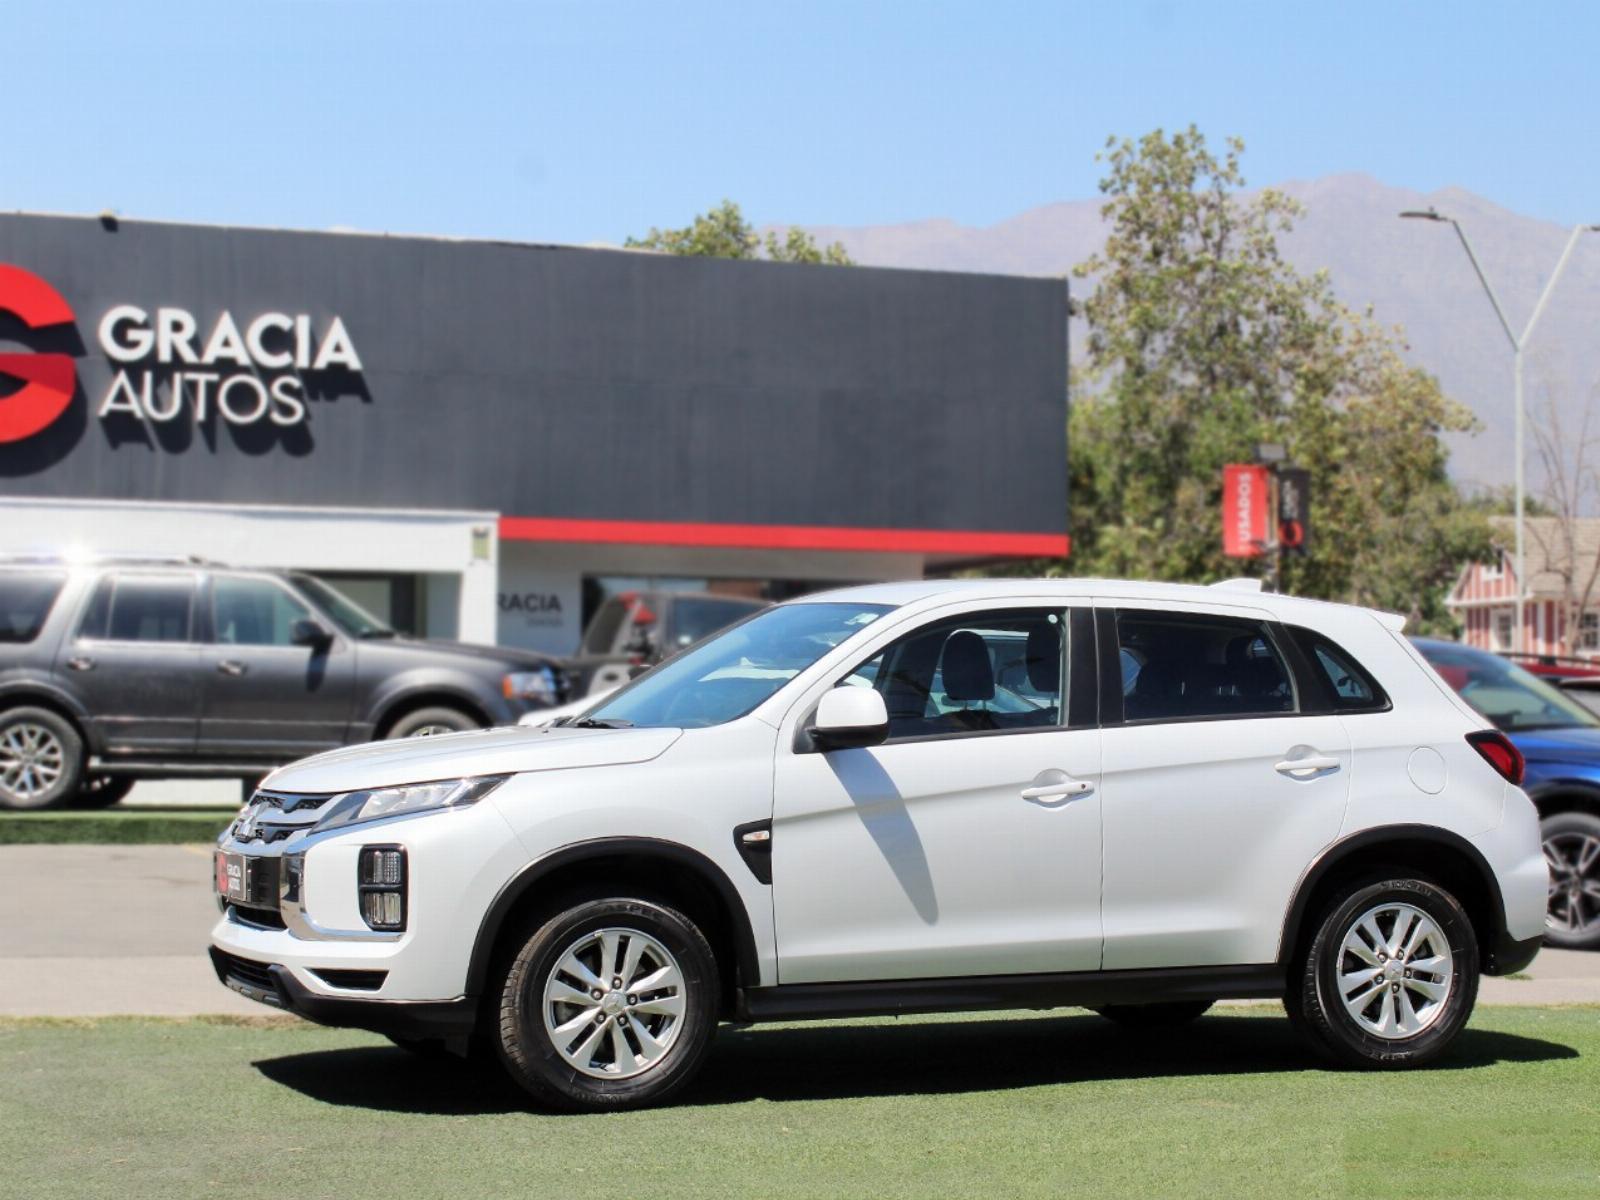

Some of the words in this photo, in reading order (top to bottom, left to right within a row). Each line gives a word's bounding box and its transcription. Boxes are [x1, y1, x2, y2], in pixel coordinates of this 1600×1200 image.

[98, 304, 363, 371] GRACIA
[98, 369, 306, 426] AUTOS
[1237, 472, 1252, 542] USADOS
